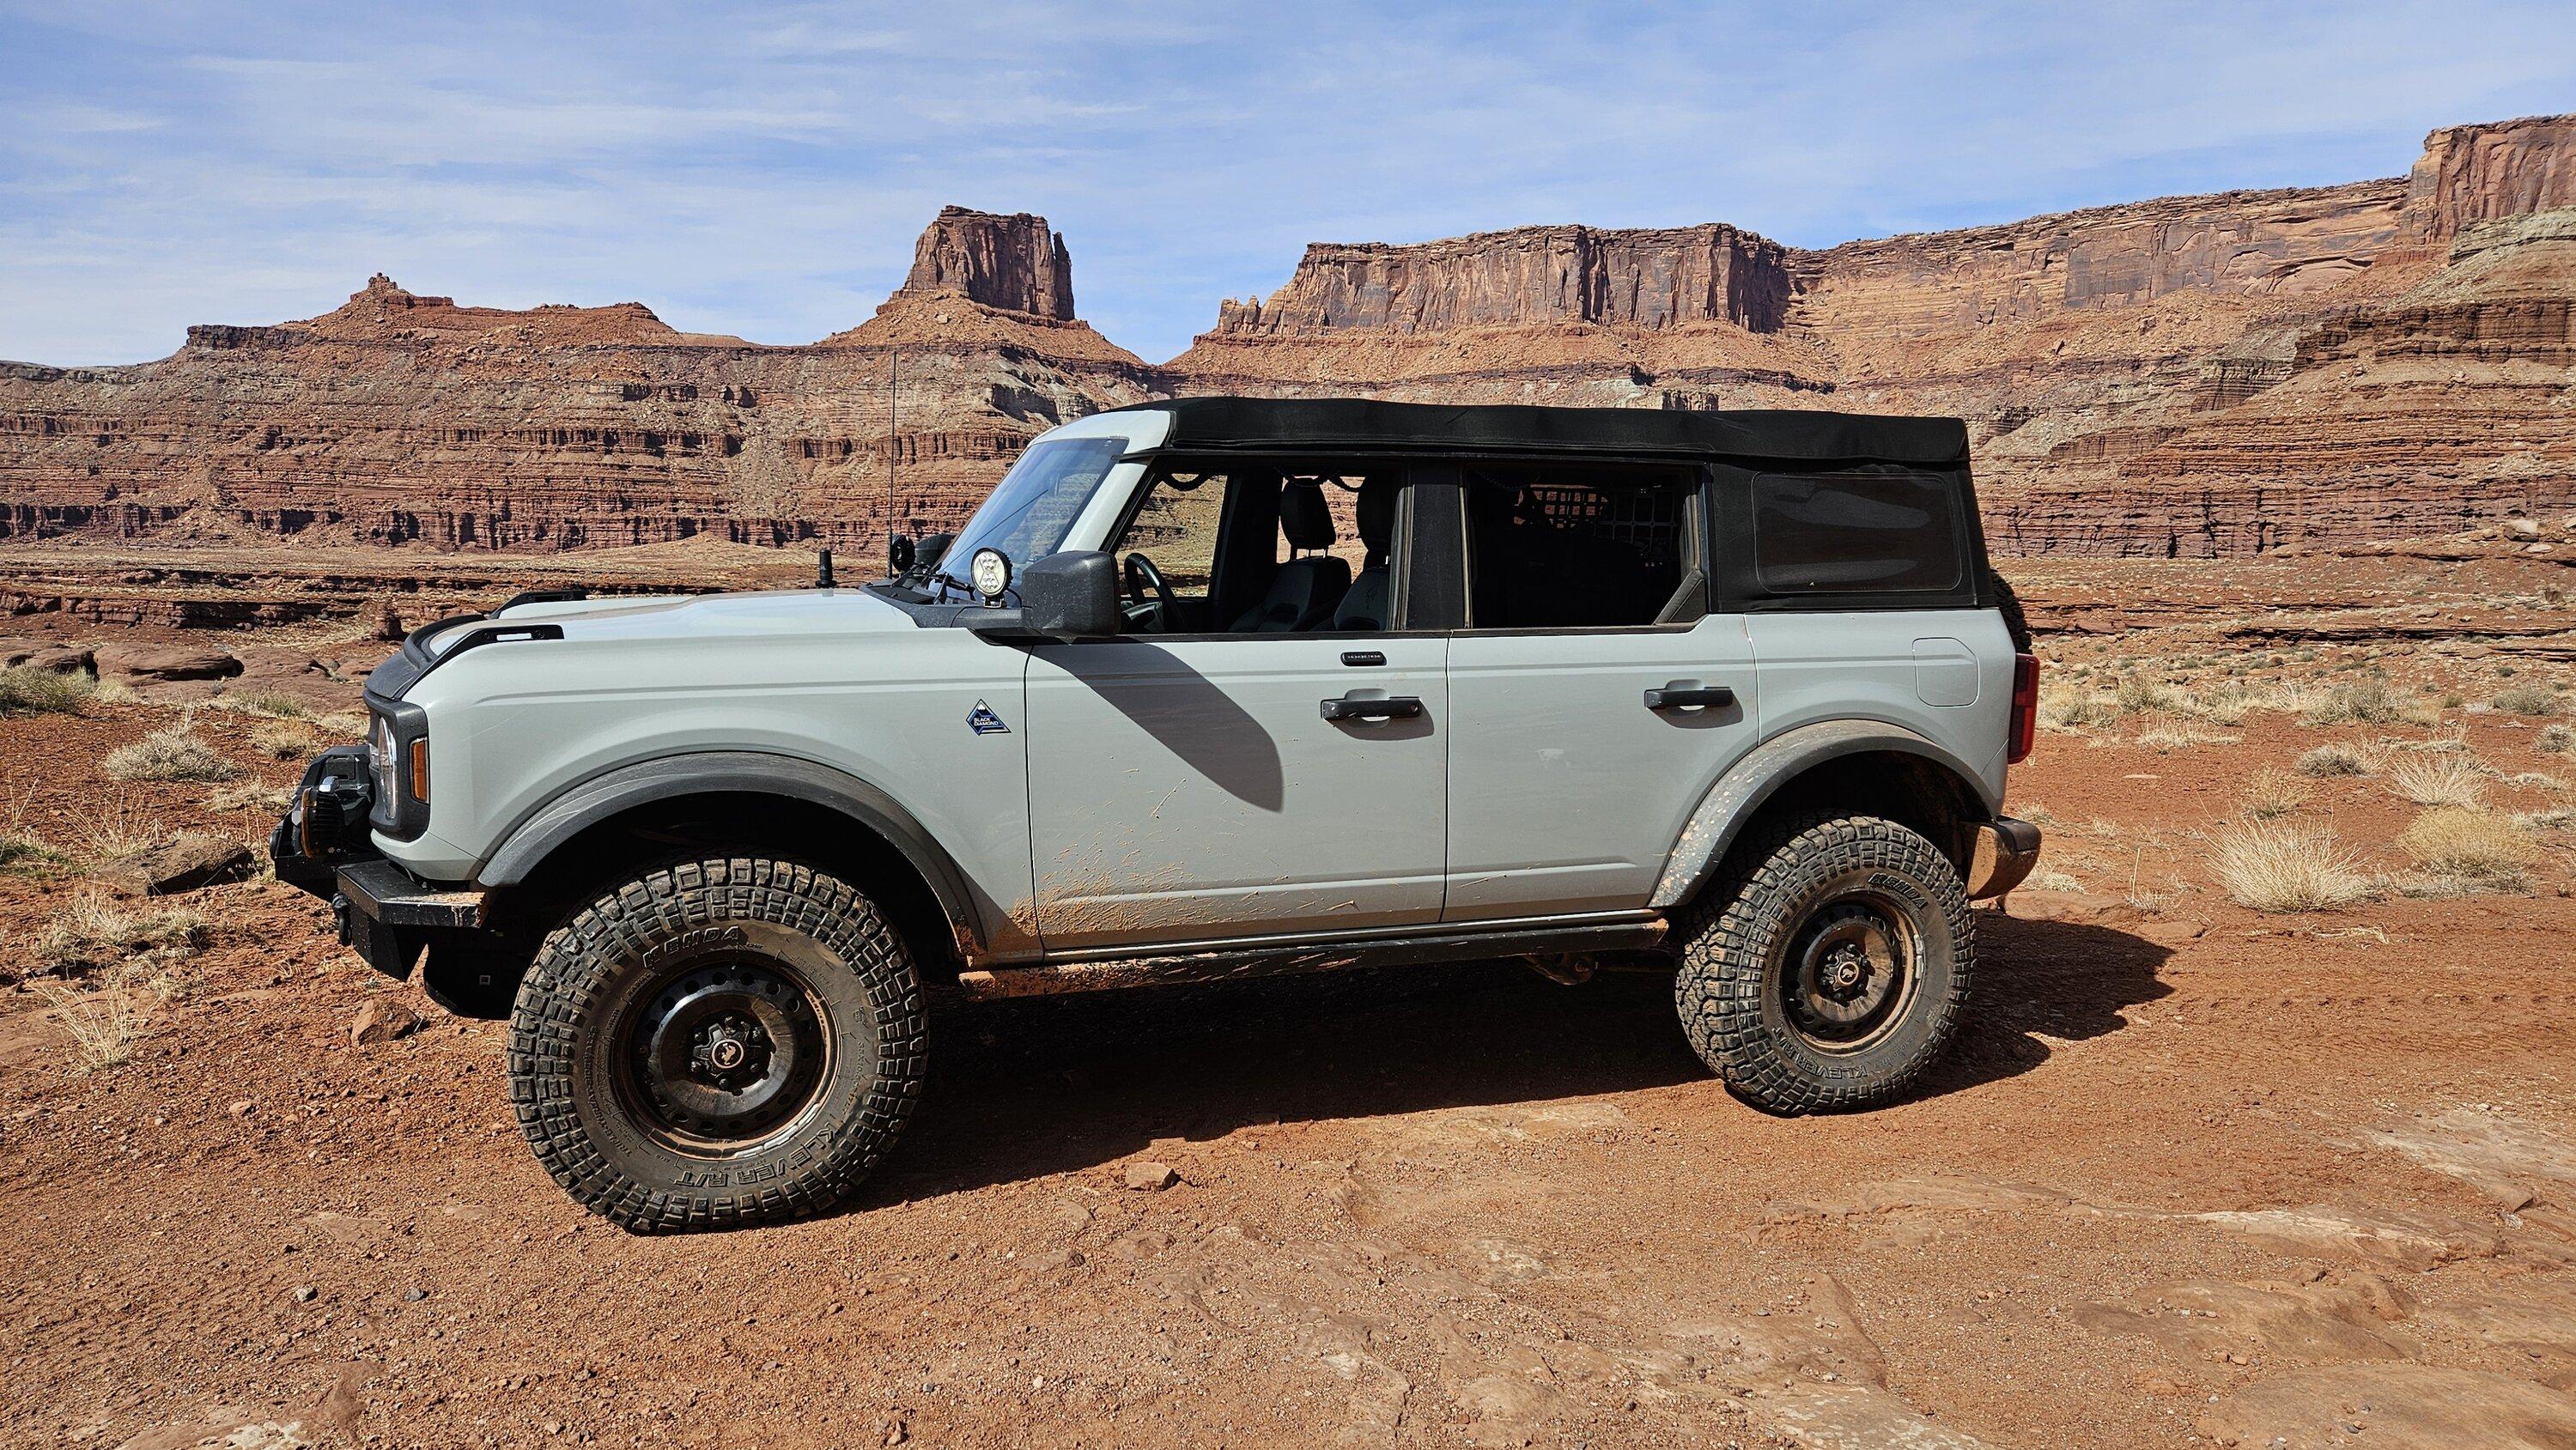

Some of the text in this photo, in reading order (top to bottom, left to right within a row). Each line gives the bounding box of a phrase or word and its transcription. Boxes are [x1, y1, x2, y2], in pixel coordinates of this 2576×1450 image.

[1868, 872, 1927, 910] KENDA
[642, 925, 739, 968] KENDA
[1794, 1053, 1868, 1079] KLEVER
[673, 1121, 834, 1187] KLEVER R/T
